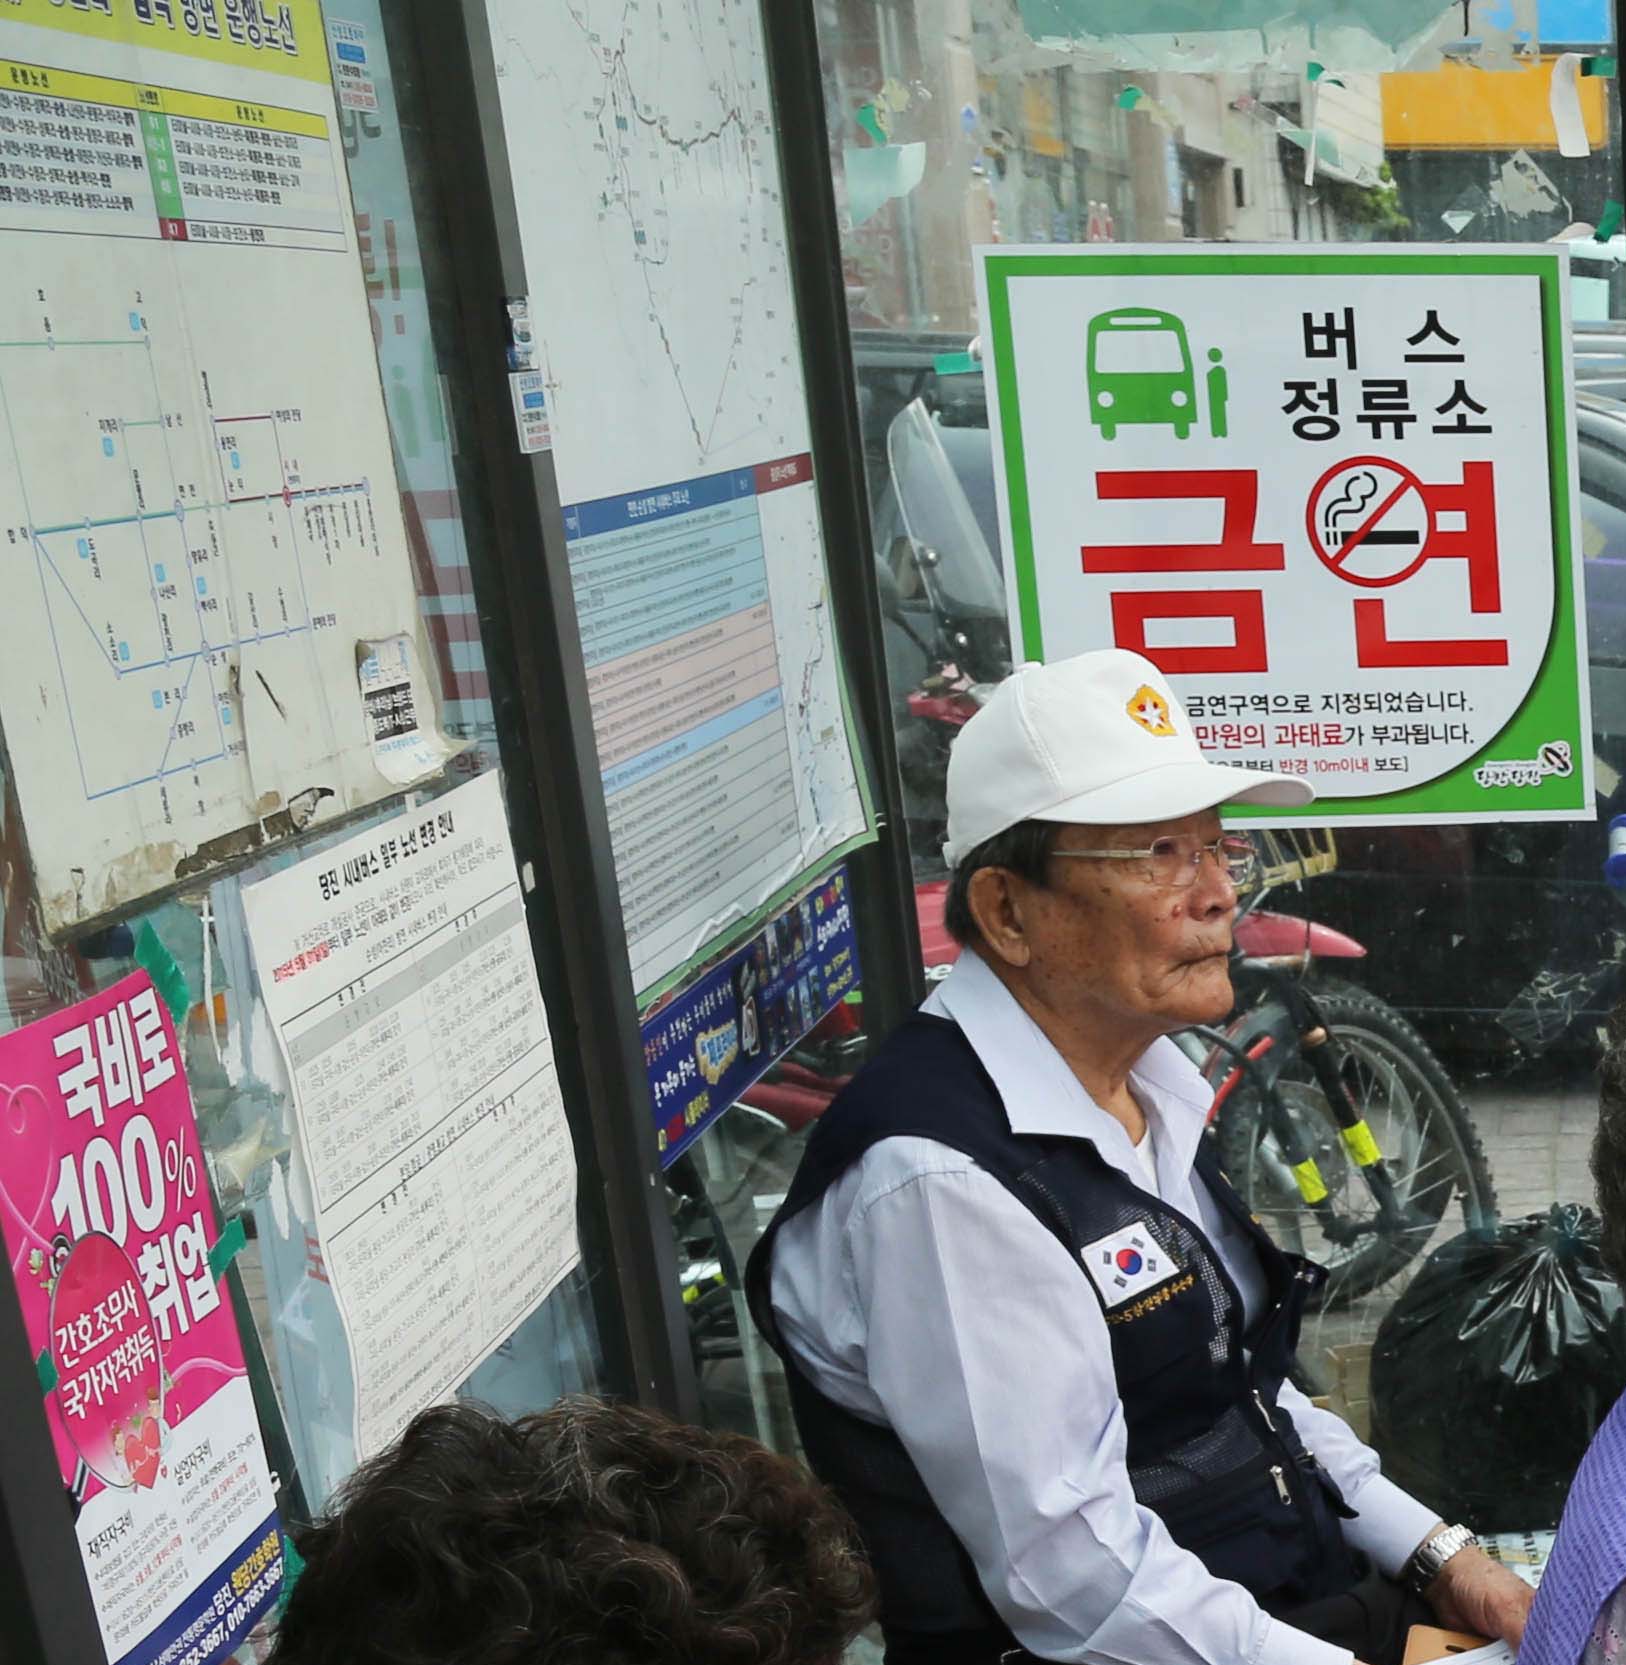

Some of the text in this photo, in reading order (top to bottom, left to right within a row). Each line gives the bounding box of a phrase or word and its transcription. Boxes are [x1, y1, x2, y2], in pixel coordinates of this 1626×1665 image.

[1281, 378, 1493, 441] 정류소
[1185, 690, 1474, 717] 금연구역으로 지정되었습니다.
[1275, 722, 1364, 750] 과태료가
[1371, 723, 1475, 746] 부과됩니다.
[1279, 757, 1308, 775] 반경
[1314, 757, 1369, 775] 10m이내
[318, 810, 455, 900] 당진 시내버스 일부 노선 변경 안내
[52, 987, 176, 1128] 국비로
[51, 1114, 197, 1249] 100%
[137, 1211, 220, 1341] 취업
[55, 1279, 140, 1369] 간호조무사
[62, 1325, 157, 1419] 국가자격취득
[212, 1582, 236, 1616] 당진
